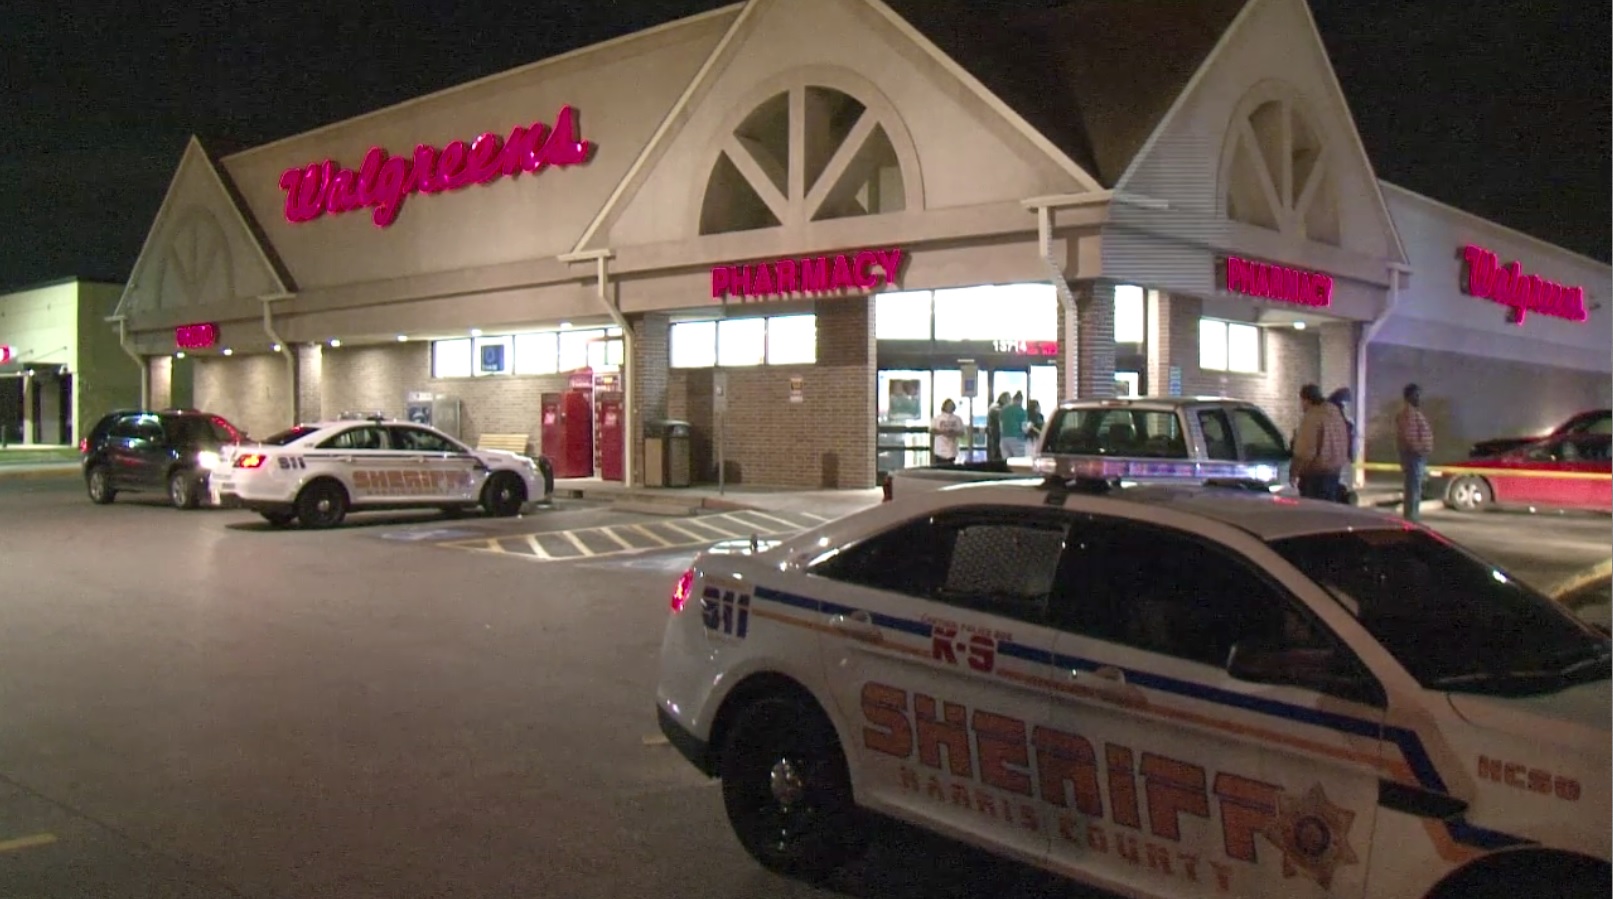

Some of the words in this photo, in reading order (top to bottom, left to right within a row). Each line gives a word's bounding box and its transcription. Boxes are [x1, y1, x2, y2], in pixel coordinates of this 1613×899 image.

[279, 104, 590, 227] Walgreens
[712, 249, 901, 299] PHARMACY
[1227, 257, 1333, 307] PHARMACY
[1464, 244, 1587, 325] Walgreens
[352, 470, 465, 488] SHERIFF
[703, 586, 751, 639] 911
[932, 624, 995, 673] K-9
[861, 681, 1285, 864] SHERIFF
[1478, 755, 1582, 801] HCSO
[1059, 811, 1232, 892] COUNTY
